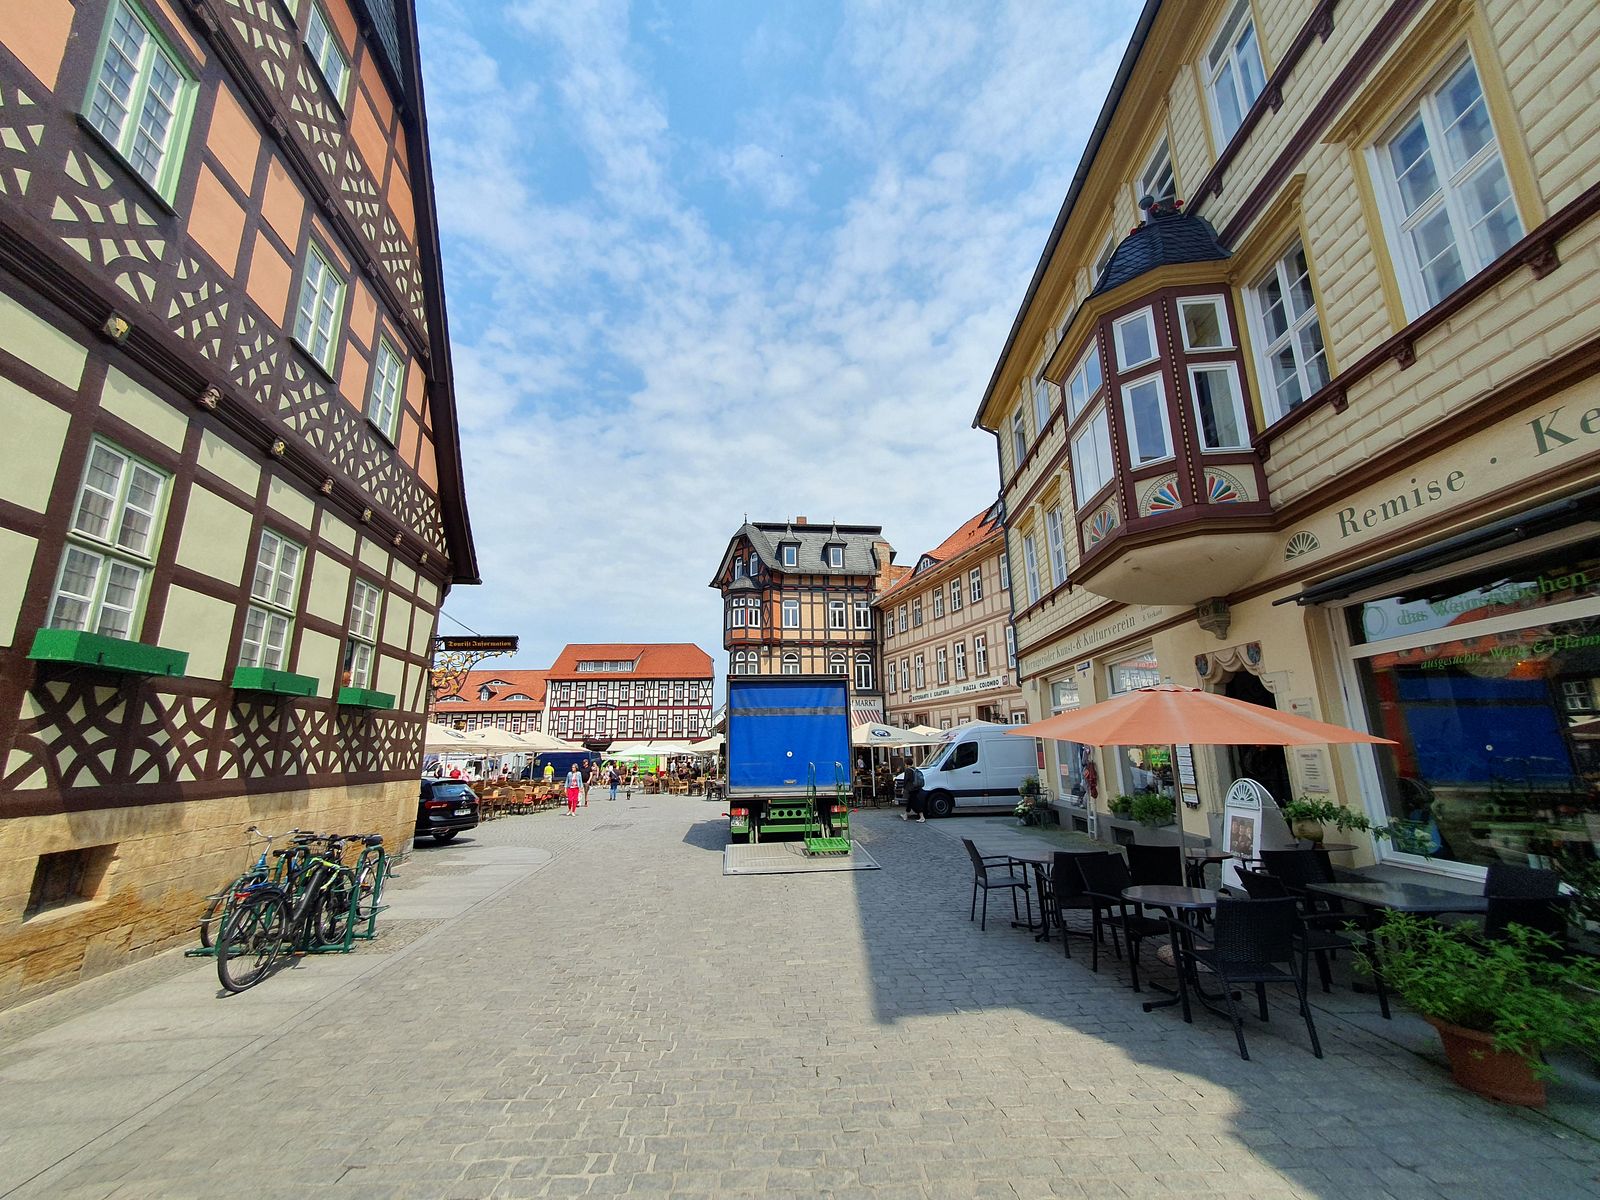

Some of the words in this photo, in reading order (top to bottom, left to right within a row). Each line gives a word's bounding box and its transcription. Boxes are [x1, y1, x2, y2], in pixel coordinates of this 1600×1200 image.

[1336, 469, 1467, 540] Remise
[1024, 649, 1056, 671] Wernigeröder
[1076, 637, 1083, 650] &
[1083, 613, 1136, 647] Kulturverein
[1420, 651, 1481, 670] ausgesuchte
[1533, 640, 1546, 653] &
[963, 684, 976, 692] PIAZZA
[979, 679, 1000, 688] COLOMBO
[855, 699, 876, 707] MARKT
